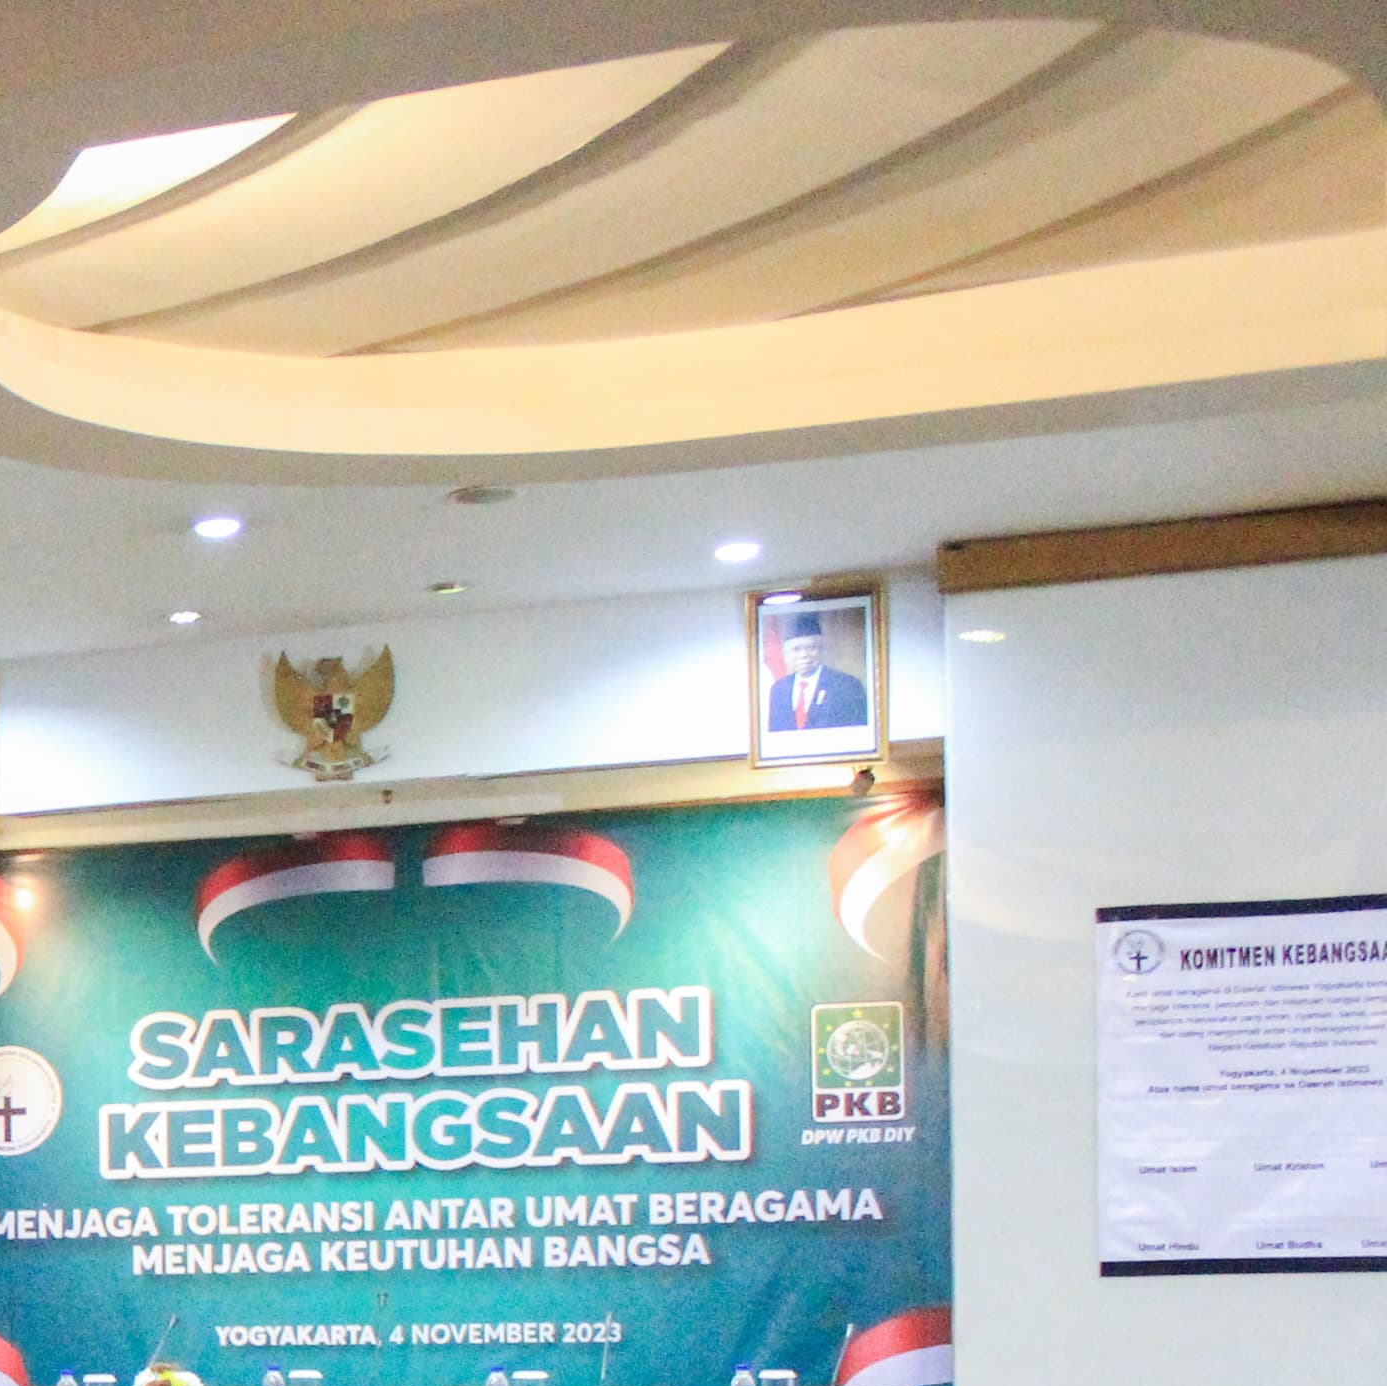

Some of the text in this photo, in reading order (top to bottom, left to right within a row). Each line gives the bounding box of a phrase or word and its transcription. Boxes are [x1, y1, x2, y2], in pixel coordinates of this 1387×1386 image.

[1180, 946, 1276, 971] KOMITMEN
[128, 986, 712, 1090] SARASEHAN
[815, 1091, 901, 1117] PKB
[99, 1079, 751, 1180] KEBANGSAAN
[801, 1126, 916, 1145] DPW PKB DIY
[166, 1201, 374, 1236] TOLERANSI
[384, 1197, 514, 1231] ANTAR
[526, 1194, 638, 1227] UMAT
[648, 1188, 883, 1225] BERAGAMA
[132, 1233, 711, 1276] MENJAGA KEUTUHAN BANGSA
[215, 1321, 622, 1347] YOGYAKARTA, 4 NOVEMBER 2023
